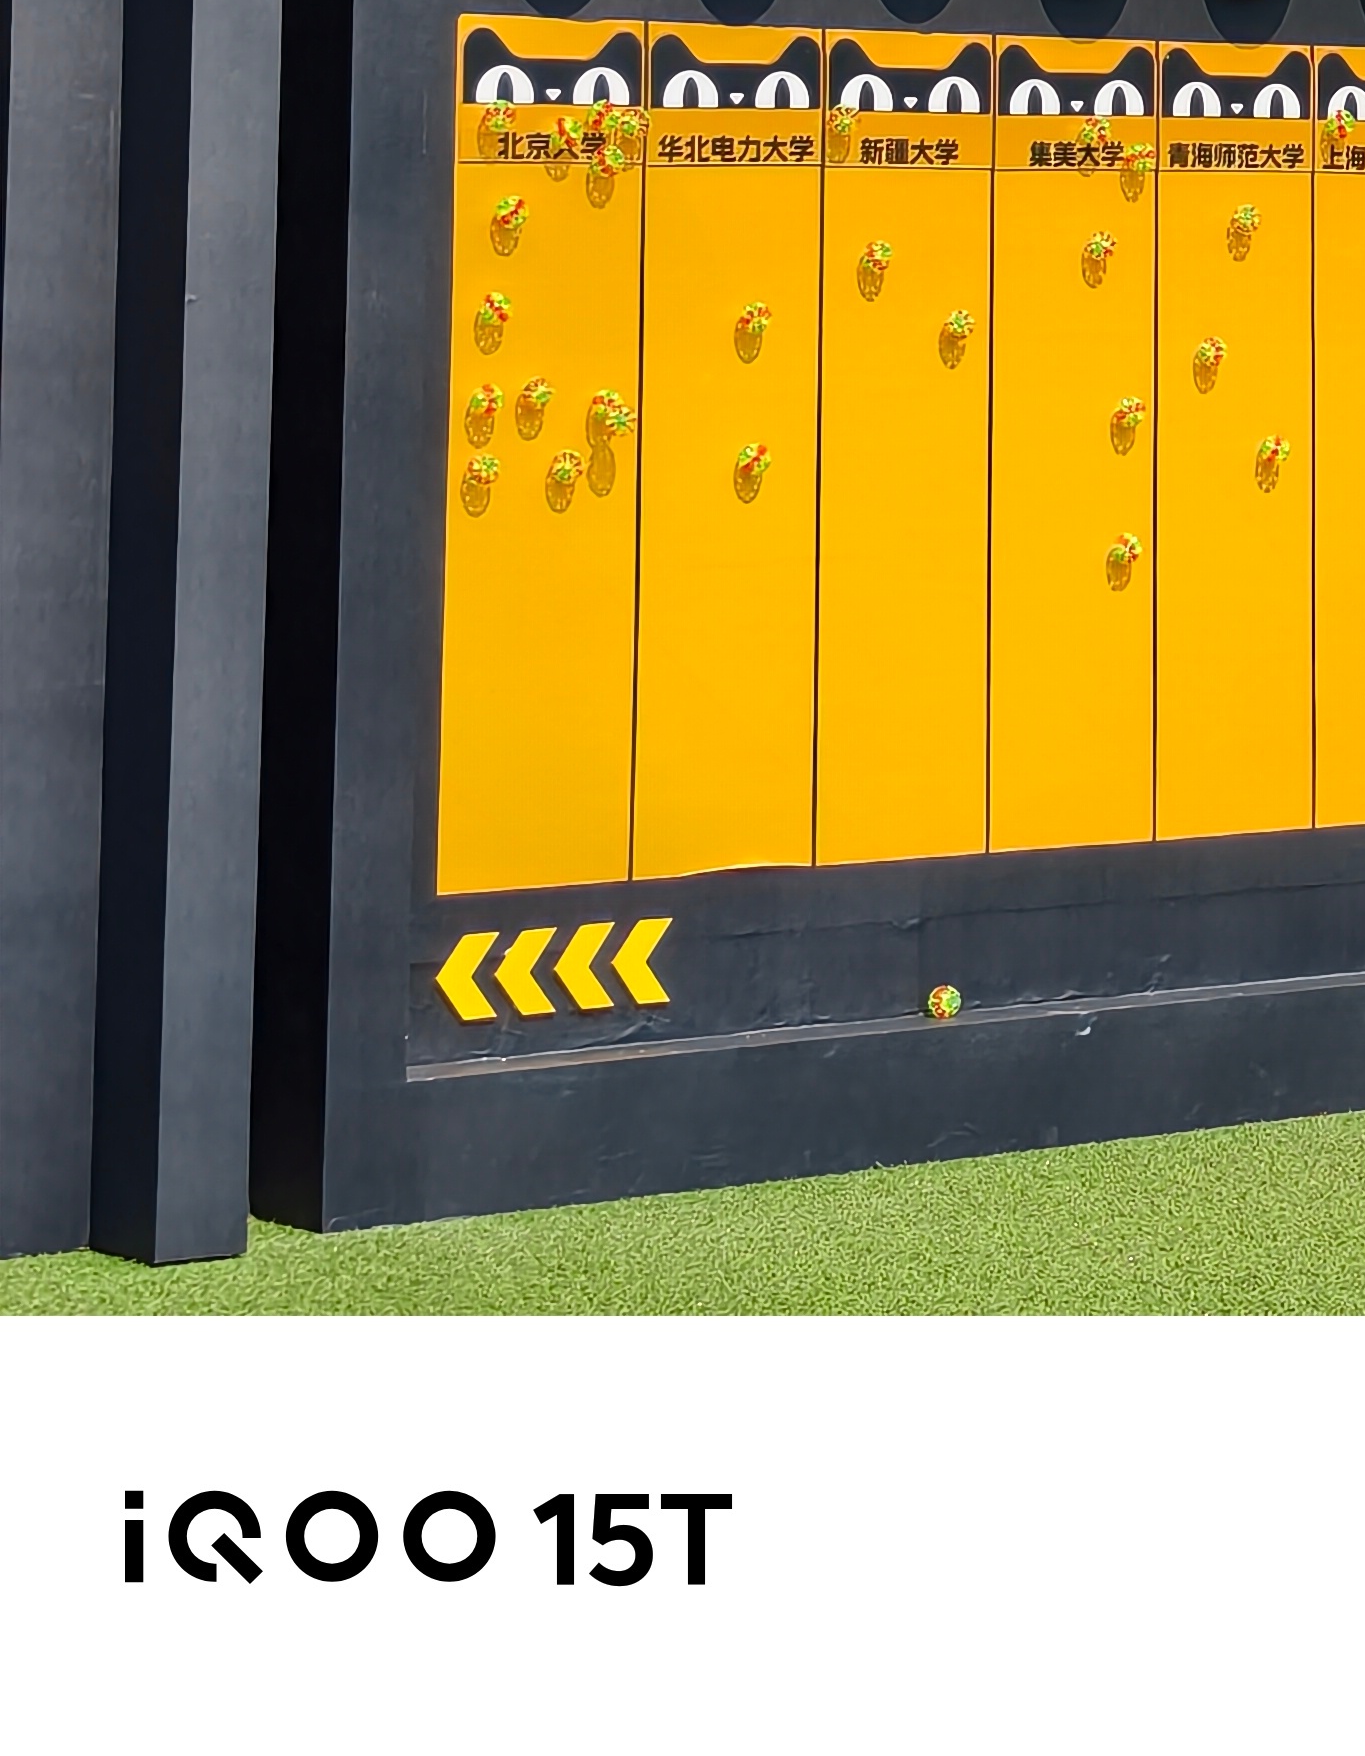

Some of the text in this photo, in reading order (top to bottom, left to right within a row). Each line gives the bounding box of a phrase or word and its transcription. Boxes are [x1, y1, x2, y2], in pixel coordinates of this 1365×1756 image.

[658, 133, 815, 164] 华北电力大学
[859, 136, 960, 166] 新疆大学
[1029, 140, 1125, 168] 集美大学
[1167, 141, 1305, 170] 青海师范大学
